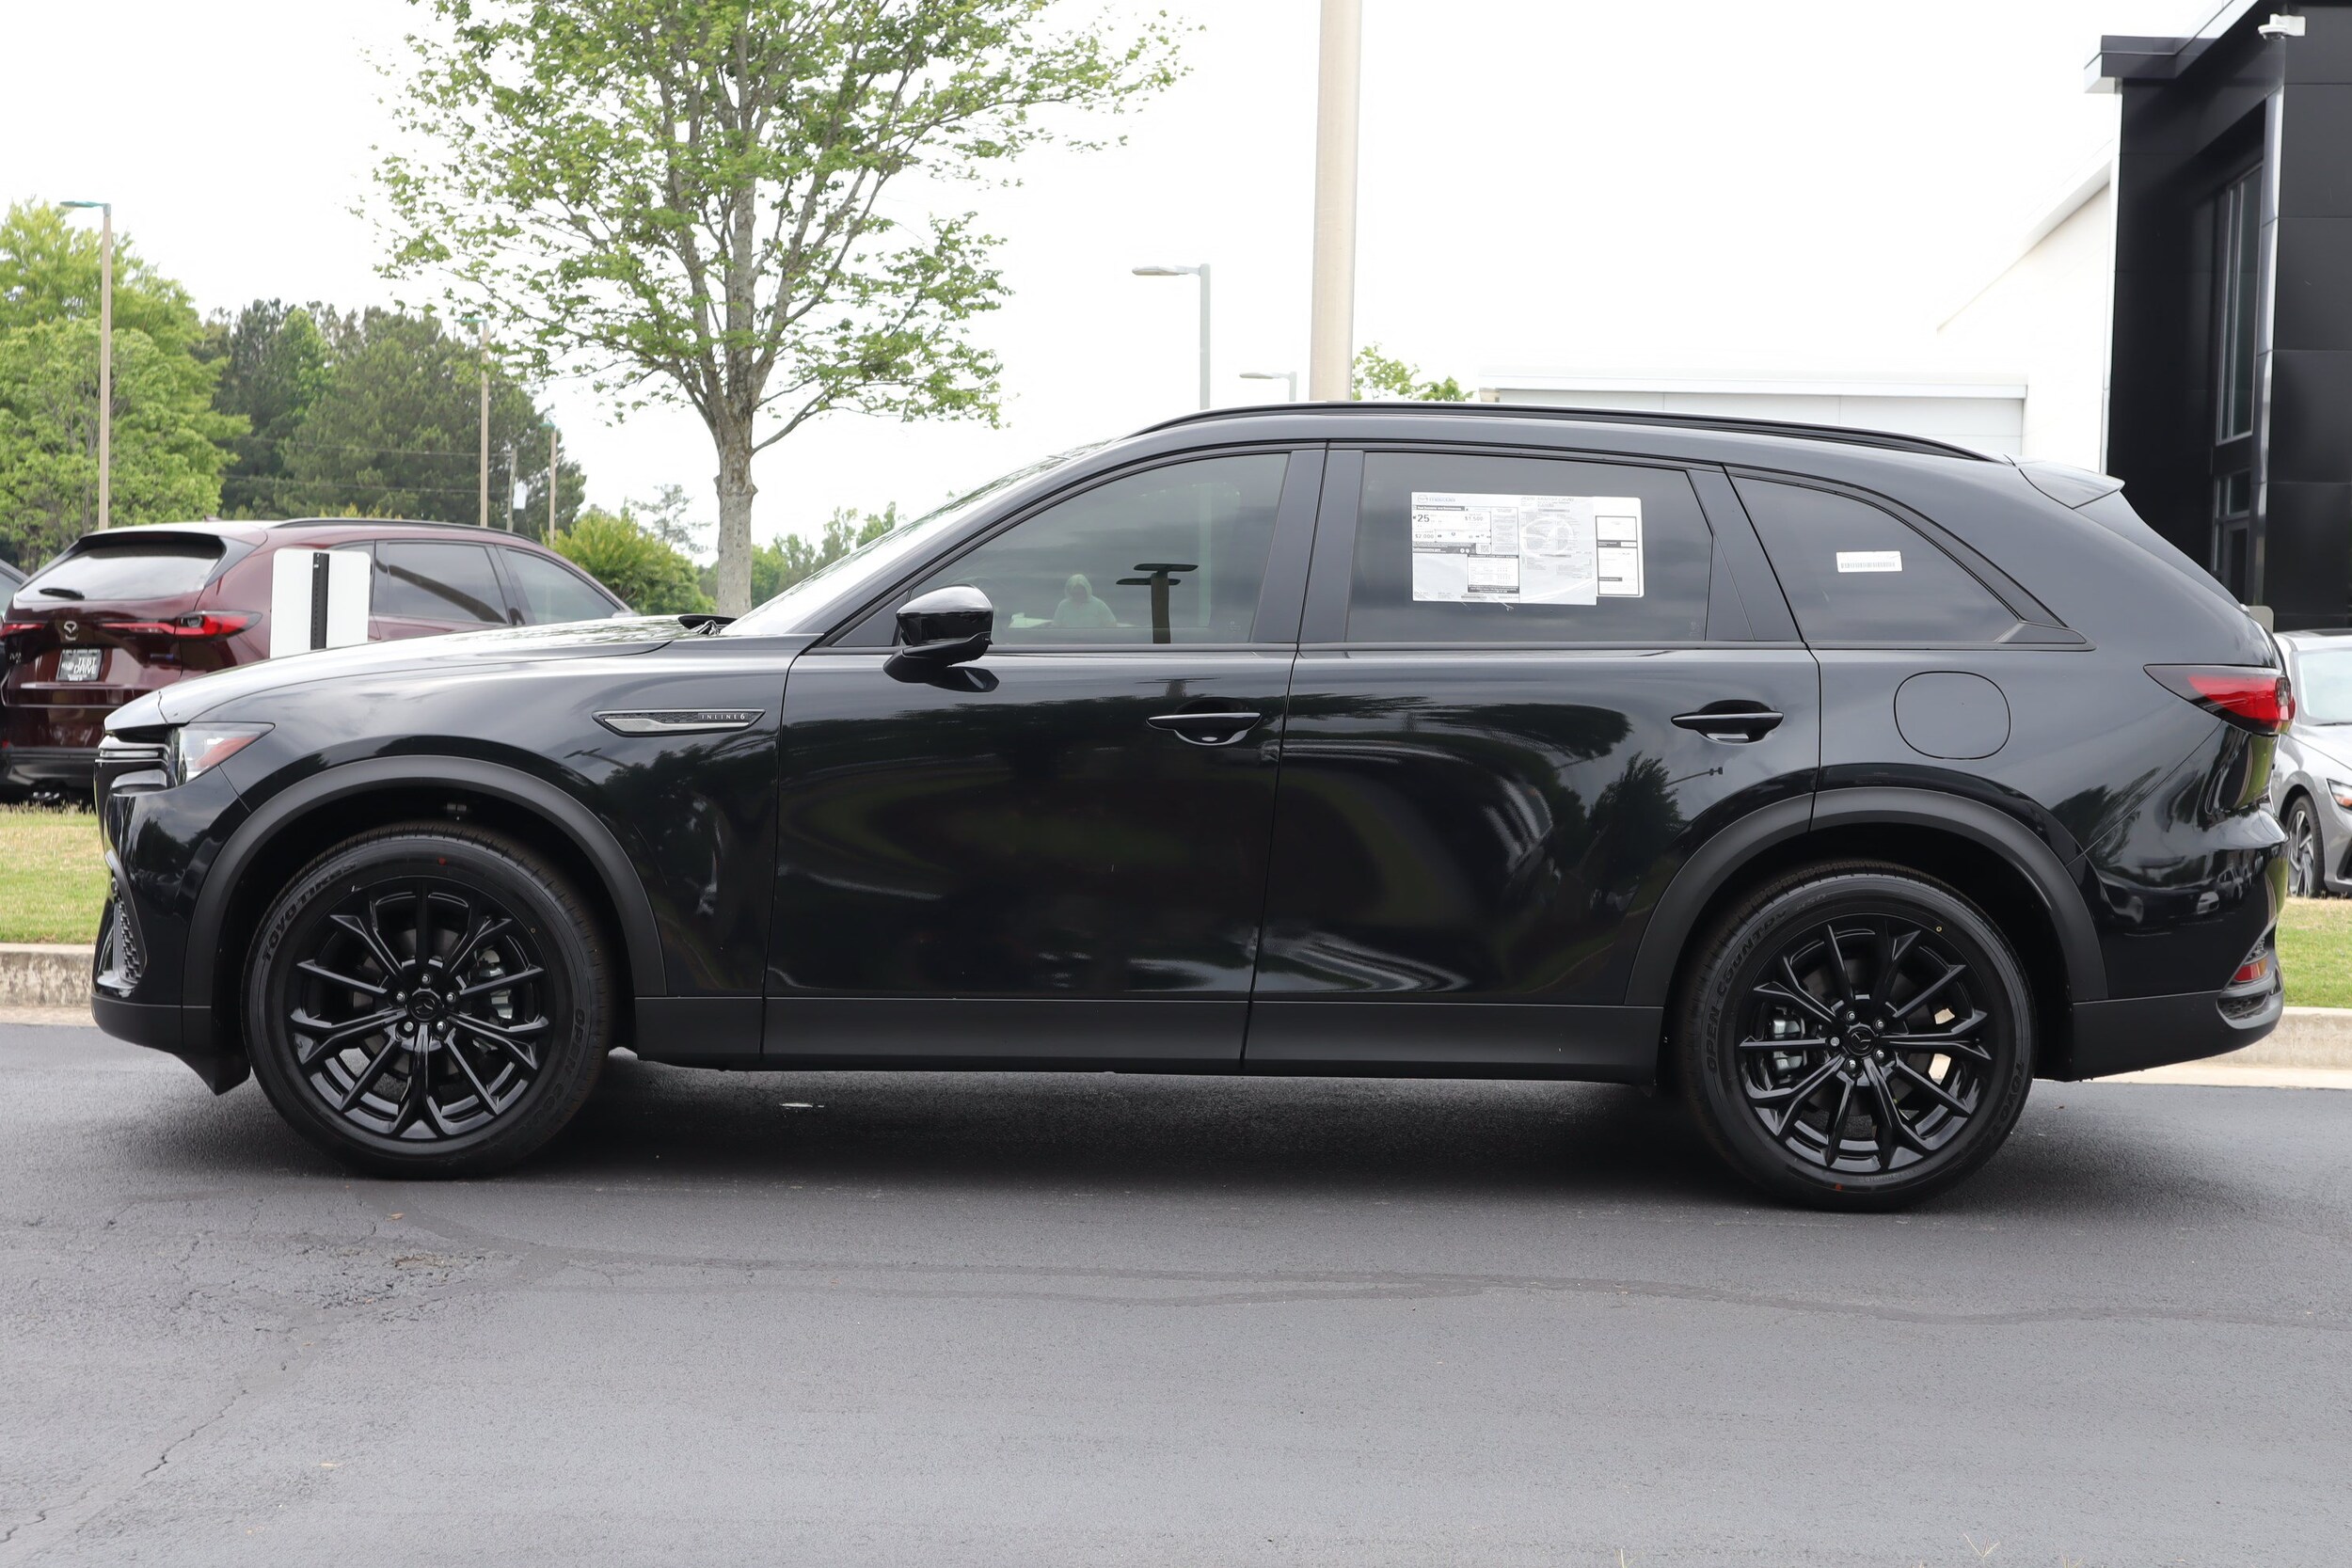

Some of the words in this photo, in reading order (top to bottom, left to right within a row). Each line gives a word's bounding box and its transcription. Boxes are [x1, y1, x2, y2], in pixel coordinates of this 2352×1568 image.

[1417, 514, 1430, 523] 25
[262, 903, 297, 961] TOYO
[1706, 1006, 1721, 1073] OPEN
[1717, 910, 1788, 998] COUNTRY
[1999, 1061, 2025, 1122] TOYO
